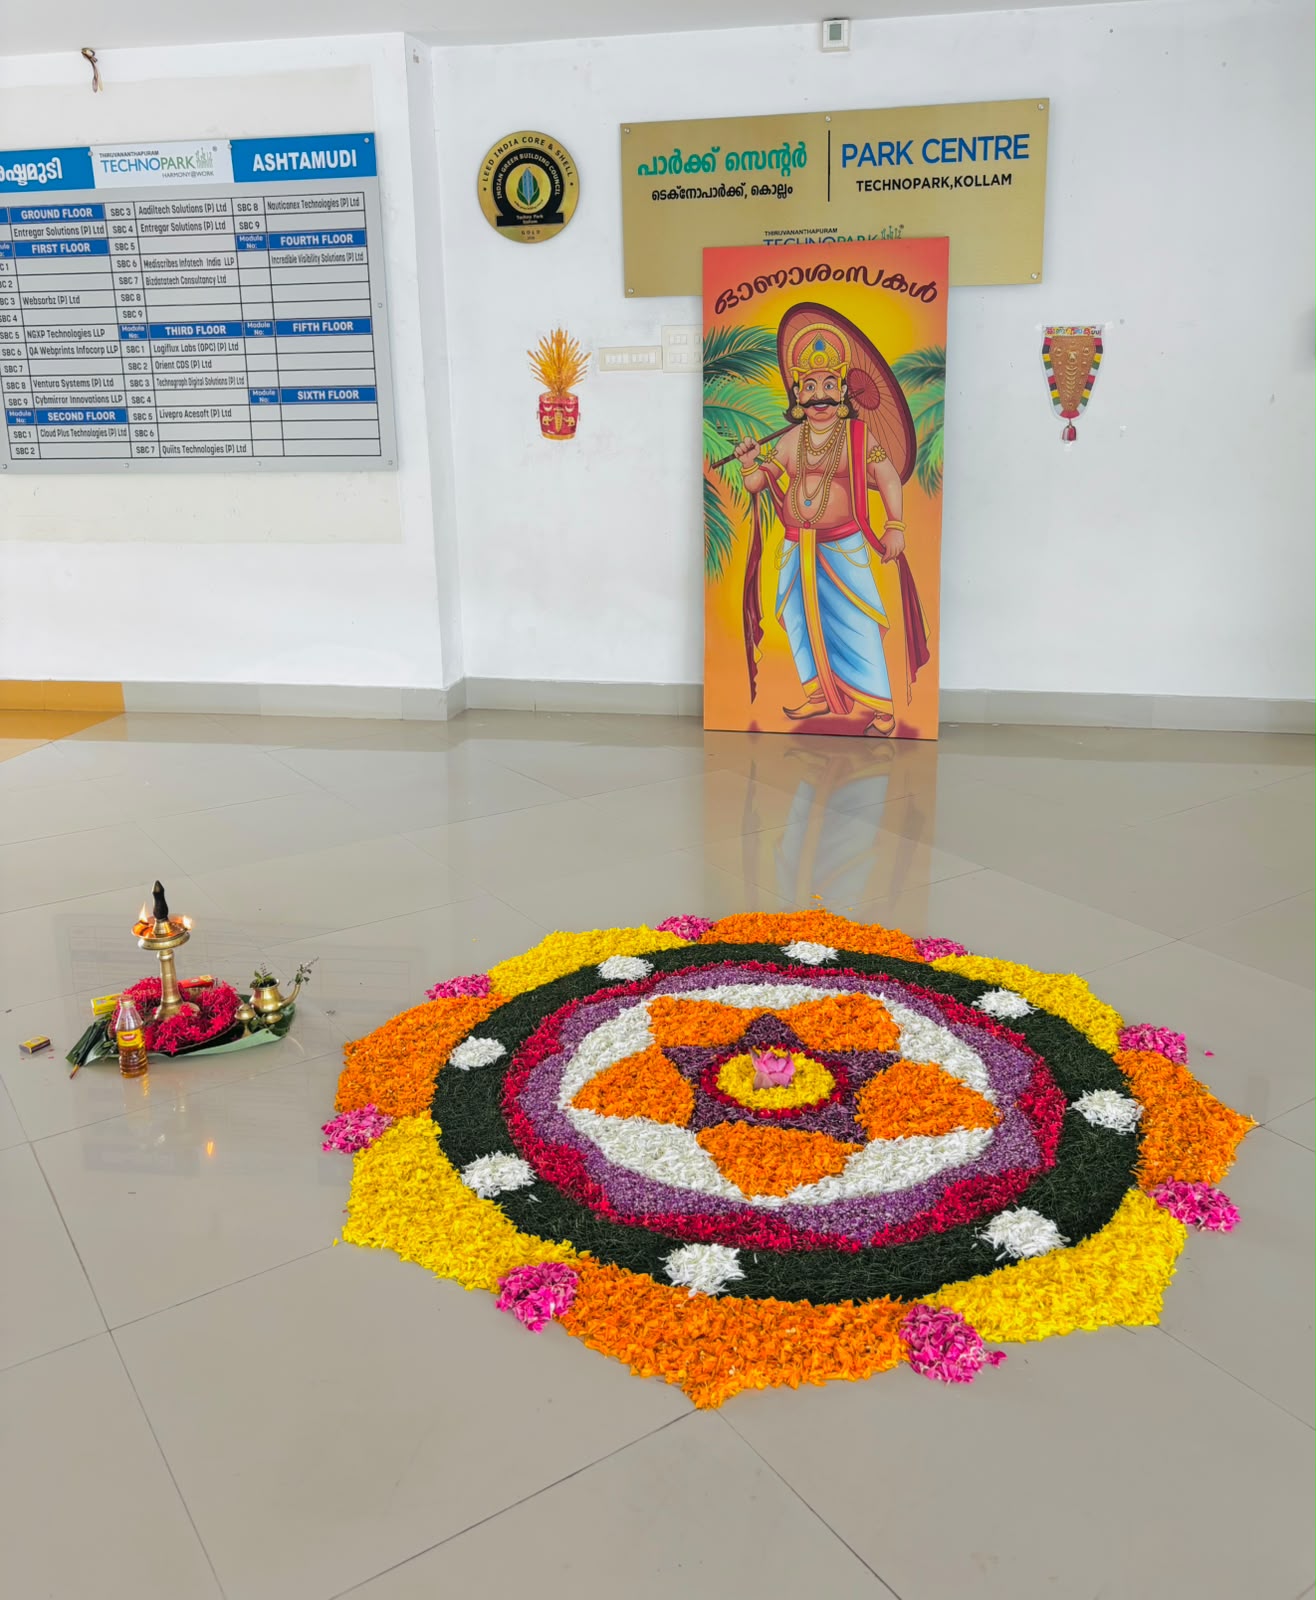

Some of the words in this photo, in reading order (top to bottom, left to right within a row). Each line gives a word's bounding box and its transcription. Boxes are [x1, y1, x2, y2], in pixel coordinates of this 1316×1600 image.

[842, 140, 913, 168] PARK
[922, 134, 1030, 163] CENTRE
[100, 155, 196, 173] TECHNOPARK
[253, 149, 357, 172] ASHTAMUDI
[483, 159, 494, 182] LEED
[494, 139, 519, 158] INDIA
[522, 136, 546, 146] CORE
[555, 150, 573, 177] SHELL
[637, 146, 720, 176] പാർക്ക്
[0, 157, 63, 186] ഷ്ടമുടി
[496, 173, 504, 199] INDIAN
[501, 156, 519, 172] GREEN
[520, 153, 549, 167] BUILDING
[549, 166, 560, 196] COUNCIL
[856, 174, 1012, 192] TECHNOPARK,KOLLAM
[751, 184, 793, 199] കൊല്ലം
[139, 205, 170, 215] Aadiltech
[172, 204, 203, 213] Solutions
[205, 203, 214, 212] (P)
[216, 203, 227, 212] Ltd
[237, 203, 254, 212] SBC
[302, 198, 339, 210] Technologies
[340, 198, 349, 207] (P)
[350, 197, 359, 207] Ltd
[21, 209, 60, 220] GROUND
[62, 208, 93, 218] FLOOR
[111, 208, 126, 216] SBC
[14, 226, 44, 238] Entregar
[46, 225, 80, 236] Solutions
[80, 224, 91, 235] (P)
[92, 224, 105, 234] Ltd
[141, 223, 169, 234] Entregar
[171, 222, 203, 231] Solutions
[204, 221, 213, 231] (P)
[215, 221, 226, 230] Ltd
[239, 222, 255, 230] SBC
[765, 228, 838, 236] THIRUVANANTHAPURAM
[280, 236, 319, 246] FOURTH
[322, 234, 353, 244] FLOOR
[32, 244, 58, 254] FIRST
[60, 243, 91, 253] FLOOR
[180, 258, 203, 268] Infotech
[207, 257, 221, 266] India
[225, 257, 234, 266] LLP
[321, 254, 345, 263] Solutions
[355, 252, 364, 262] Ltd
[117, 260, 131, 268] SBC
[181, 275, 216, 286] Consultancy
[217, 275, 227, 284] Ltd
[715, 263, 937, 314] ഓണാശംസകൾ
[58, 296, 68, 305] (P)
[69, 295, 80, 305] Ltd
[165, 326, 193, 336] THIRD
[196, 325, 226, 335] FLOOR
[293, 322, 320, 332] FIFTH
[322, 321, 354, 331] FLOOR
[27, 330, 45, 339] NGXP
[47, 329, 92, 340] Technologies
[93, 328, 105, 338] LLP
[29, 347, 38, 356] QA
[40, 346, 75, 357] Webprints
[76, 346, 105, 356] Infocorp
[106, 345, 118, 354] LLP
[181, 343, 196, 352] Labs
[198, 343, 216, 352] (OPC)
[217, 343, 227, 352] (P)
[228, 342, 239, 351] Ltd
[155, 360, 175, 370] Orient
[191, 360, 200, 369] (P)
[202, 360, 212, 368] Ltd
[33, 379, 60, 388] Ventura
[61, 379, 90, 389] Systems
[91, 378, 102, 388] (P)
[103, 378, 114, 387] Ltd
[70, 394, 109, 404] Innovations
[111, 395, 122, 404] LLP
[298, 390, 326, 400] SIXTH
[328, 390, 359, 400] FLOOR
[48, 412, 84, 421] SECOND
[86, 411, 116, 420] FLOOR
[160, 409, 183, 420] Livepro
[184, 409, 209, 418] Acesoft
[210, 409, 220, 418] (P)
[222, 408, 232, 417] Ltd
[40, 429, 56, 438] Cloud
[57, 428, 70, 437] Plus
[70, 428, 107, 439] Technologies
[118, 428, 127, 437] Ltd
[182, 445, 224, 455] Technologies
[225, 444, 234, 453] (P)
[236, 444, 247, 453] Ltd
